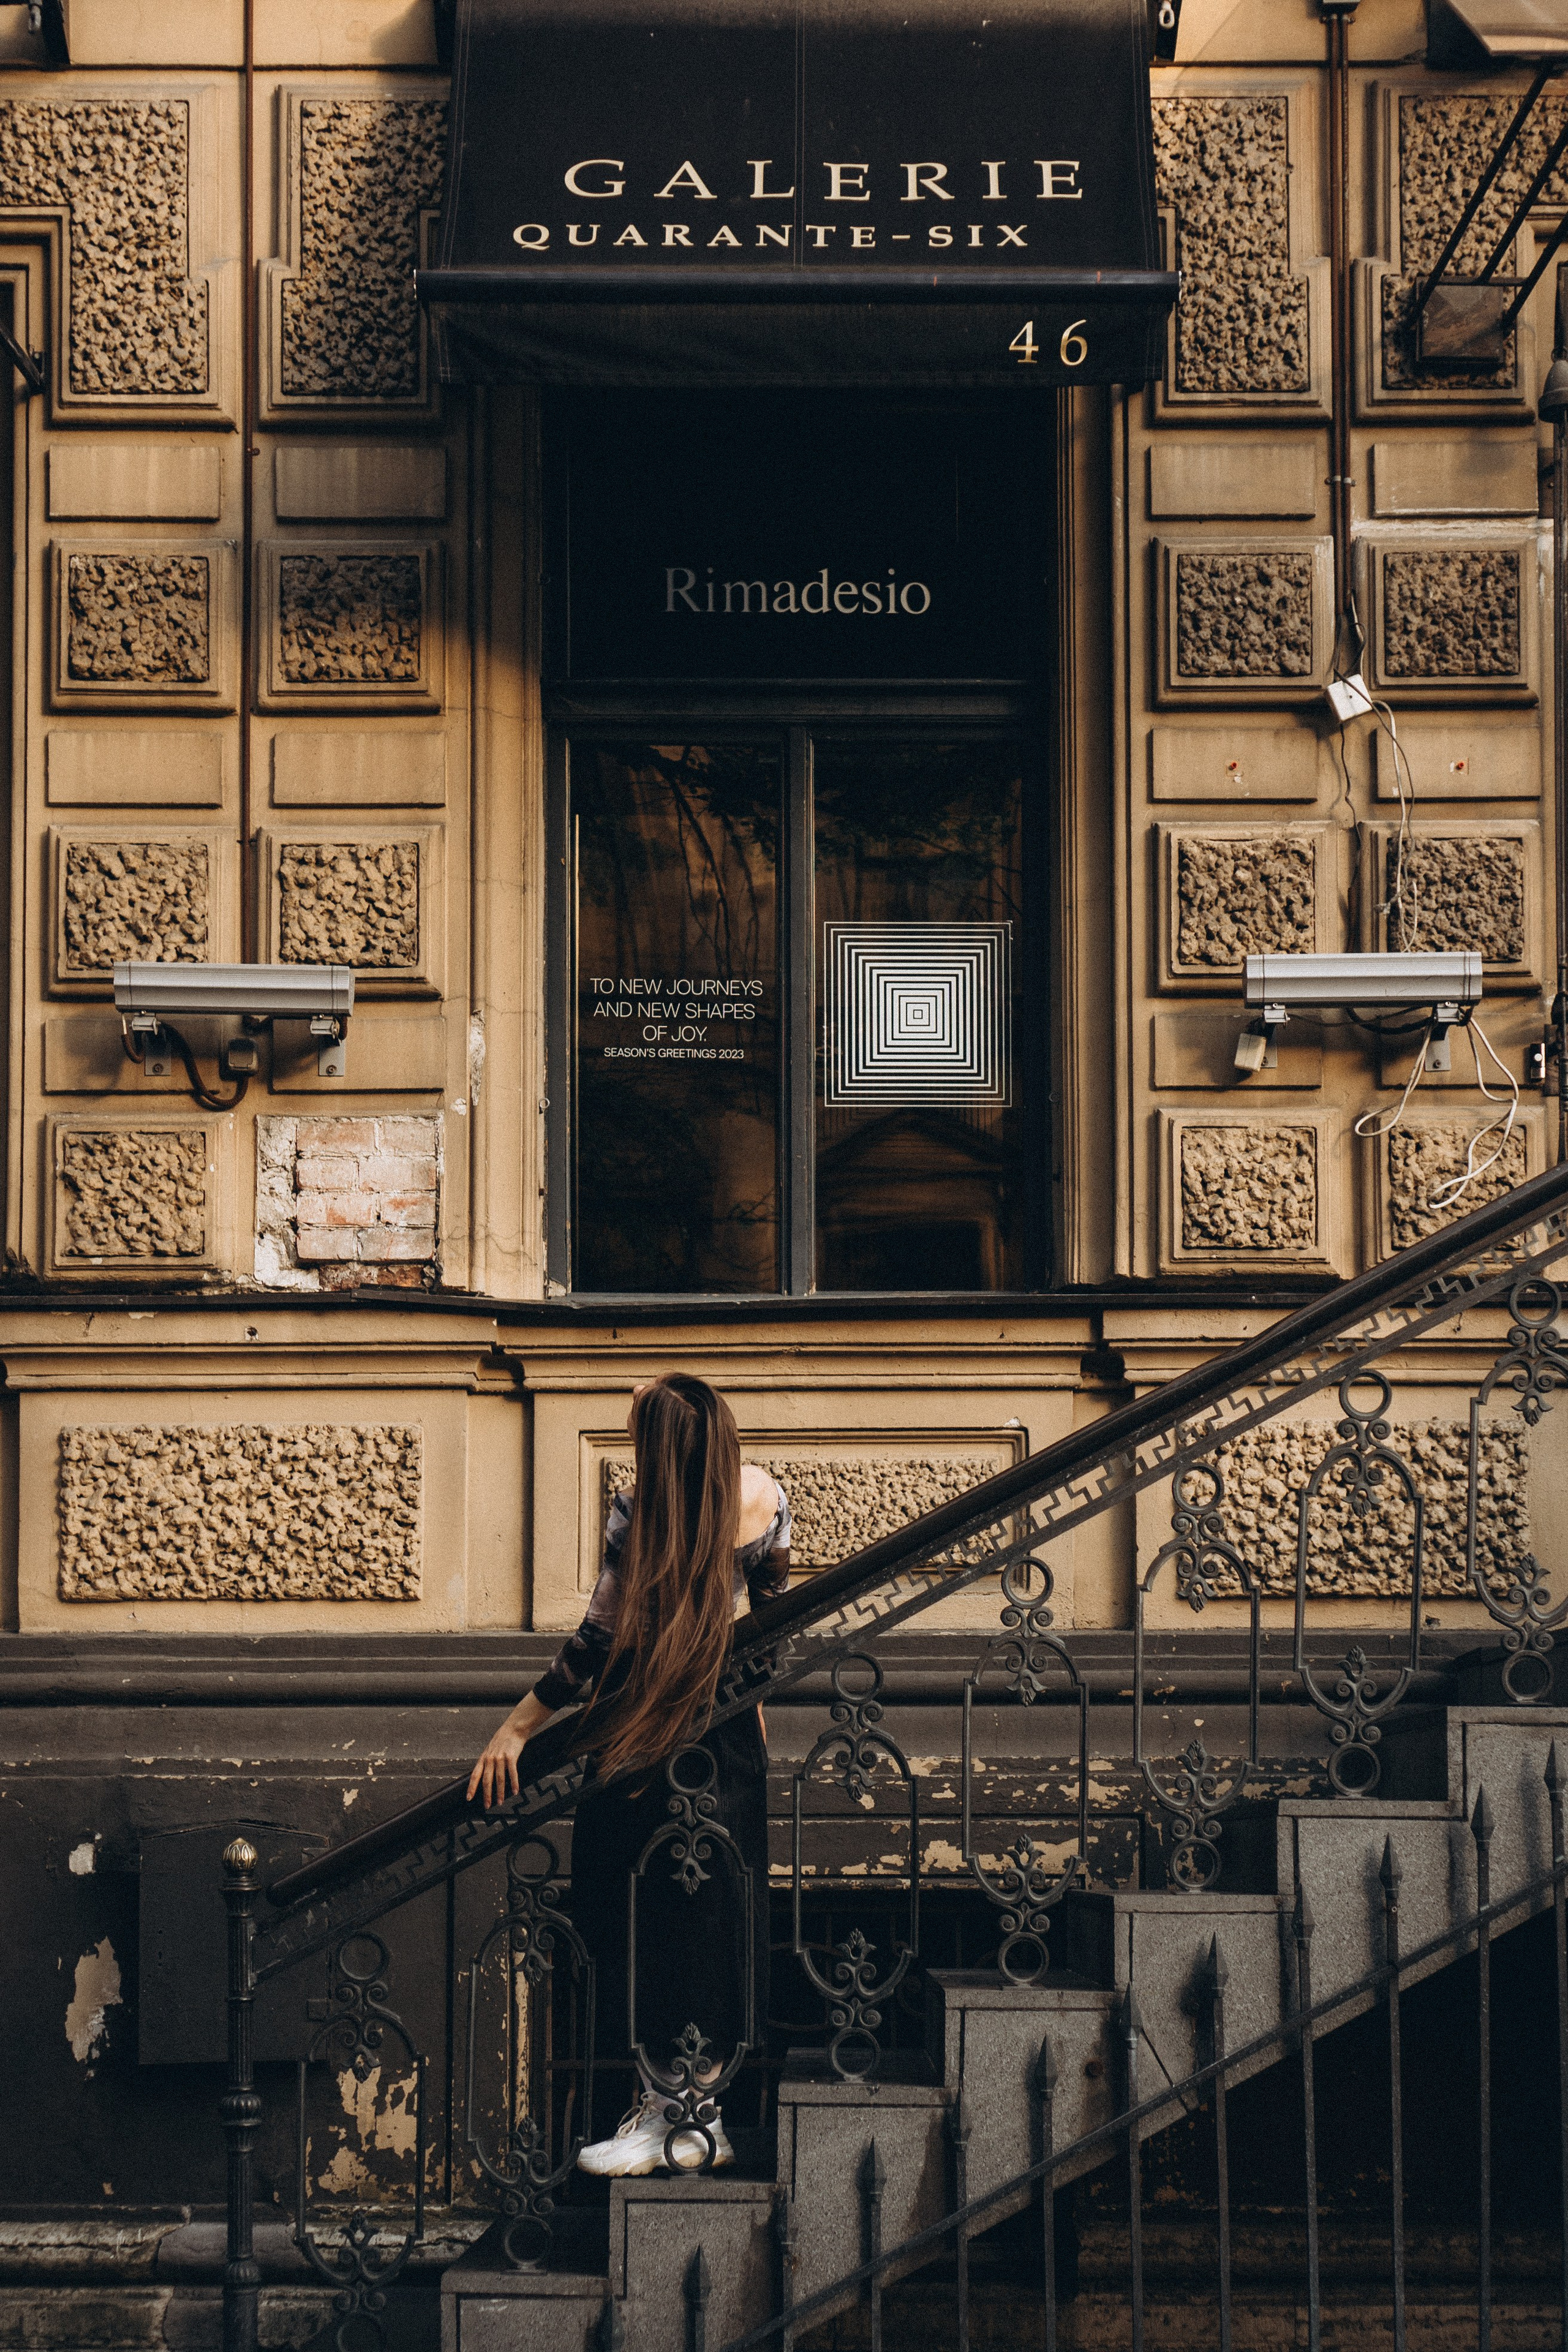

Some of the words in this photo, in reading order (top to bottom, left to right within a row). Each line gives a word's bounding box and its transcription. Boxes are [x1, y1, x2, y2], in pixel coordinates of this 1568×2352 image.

[563, 159, 1084, 202] GALERIE
[512, 223, 1029, 251] QUARANTE-SIX
[664, 567, 931, 614] Rimadesio
[590, 978, 614, 995] TO
[619, 979, 662, 995] NEW
[666, 979, 763, 997] JOURNEYS
[594, 1001, 632, 1017] AND
[638, 1003, 680, 1018] NEW
[685, 1003, 755, 1019] SHAPES
[643, 1025, 668, 1041] OF
[671, 1026, 707, 1042] JOY.
[604, 1047, 656, 1057] SEASON'S
[658, 1049, 716, 1058] GREETINGS
[718, 1049, 744, 1059] 2023
